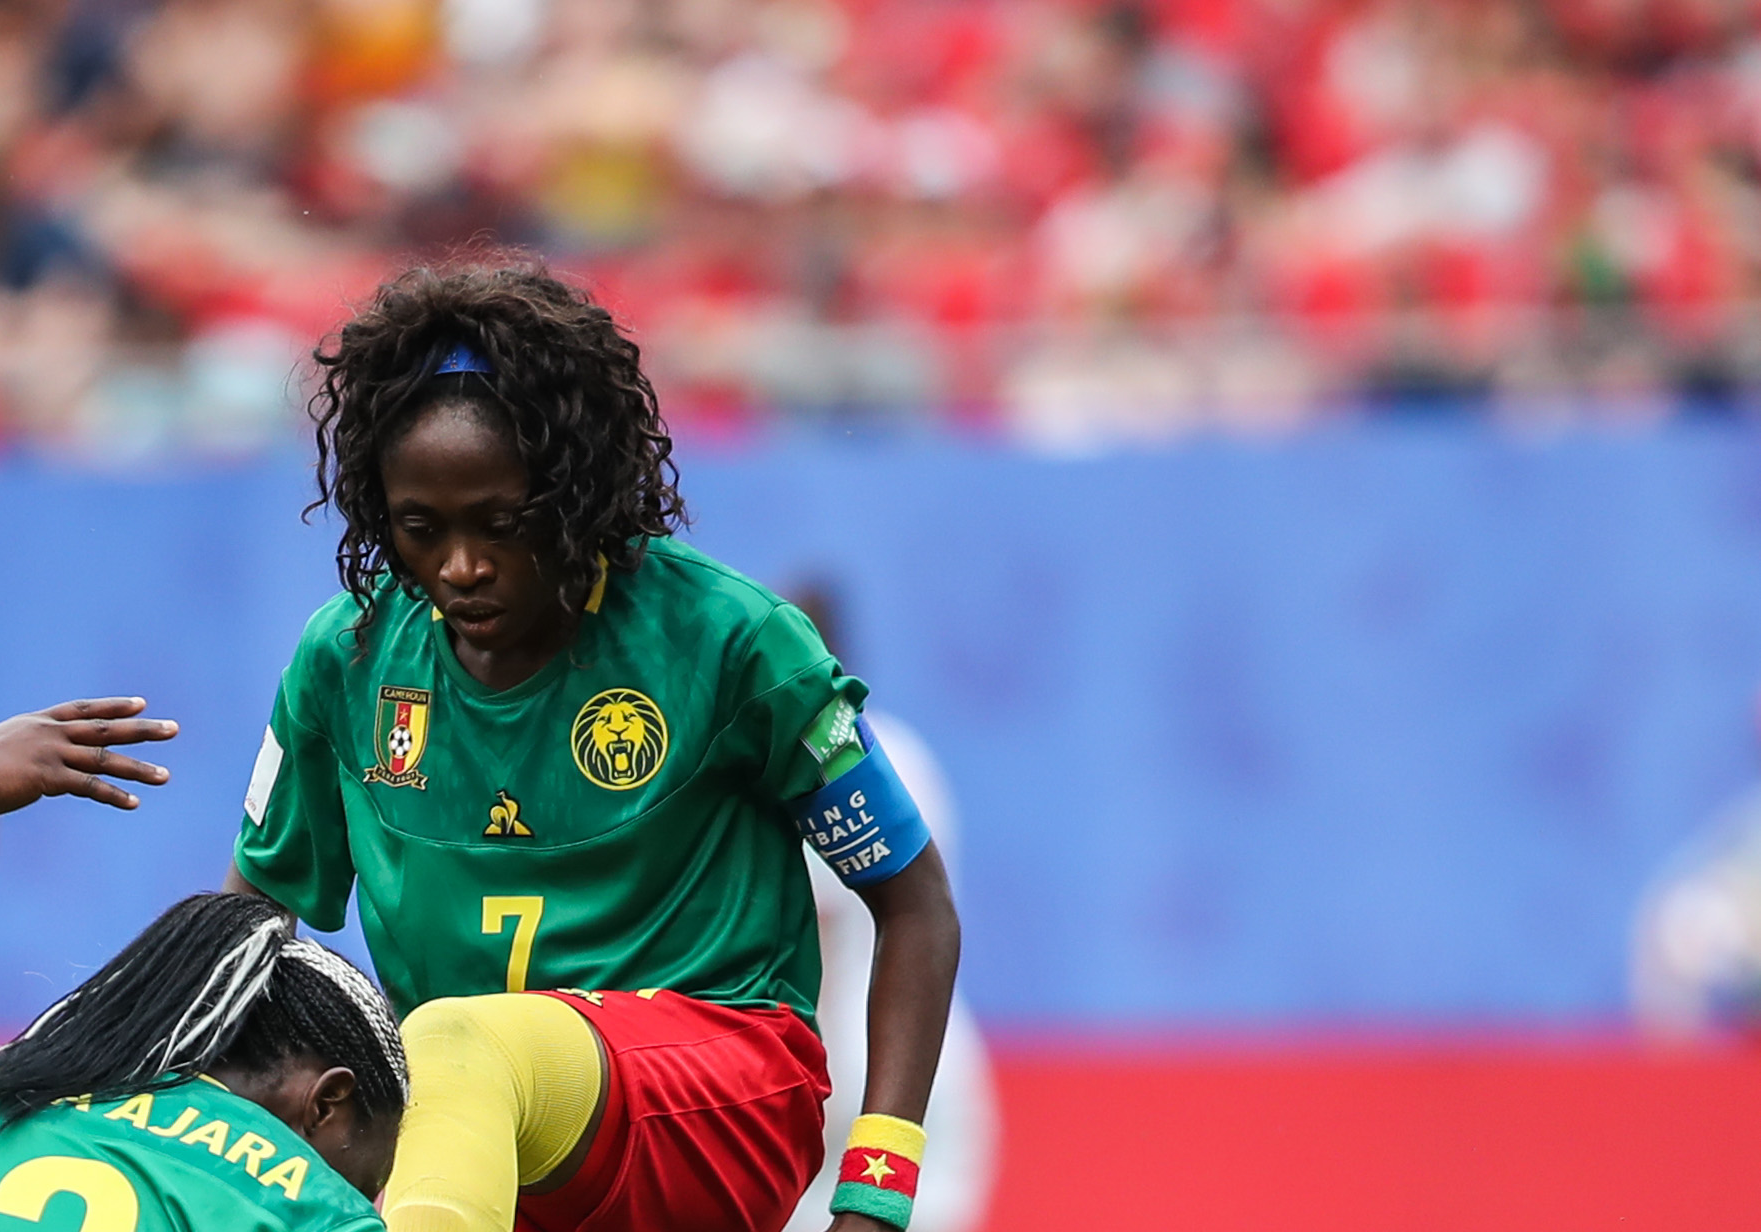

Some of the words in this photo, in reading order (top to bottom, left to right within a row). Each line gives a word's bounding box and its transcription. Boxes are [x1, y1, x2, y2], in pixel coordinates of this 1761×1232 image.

[835, 839, 892, 875] FIFA
[482, 896, 544, 992] 7
[104, 1093, 309, 1200] AJARA
